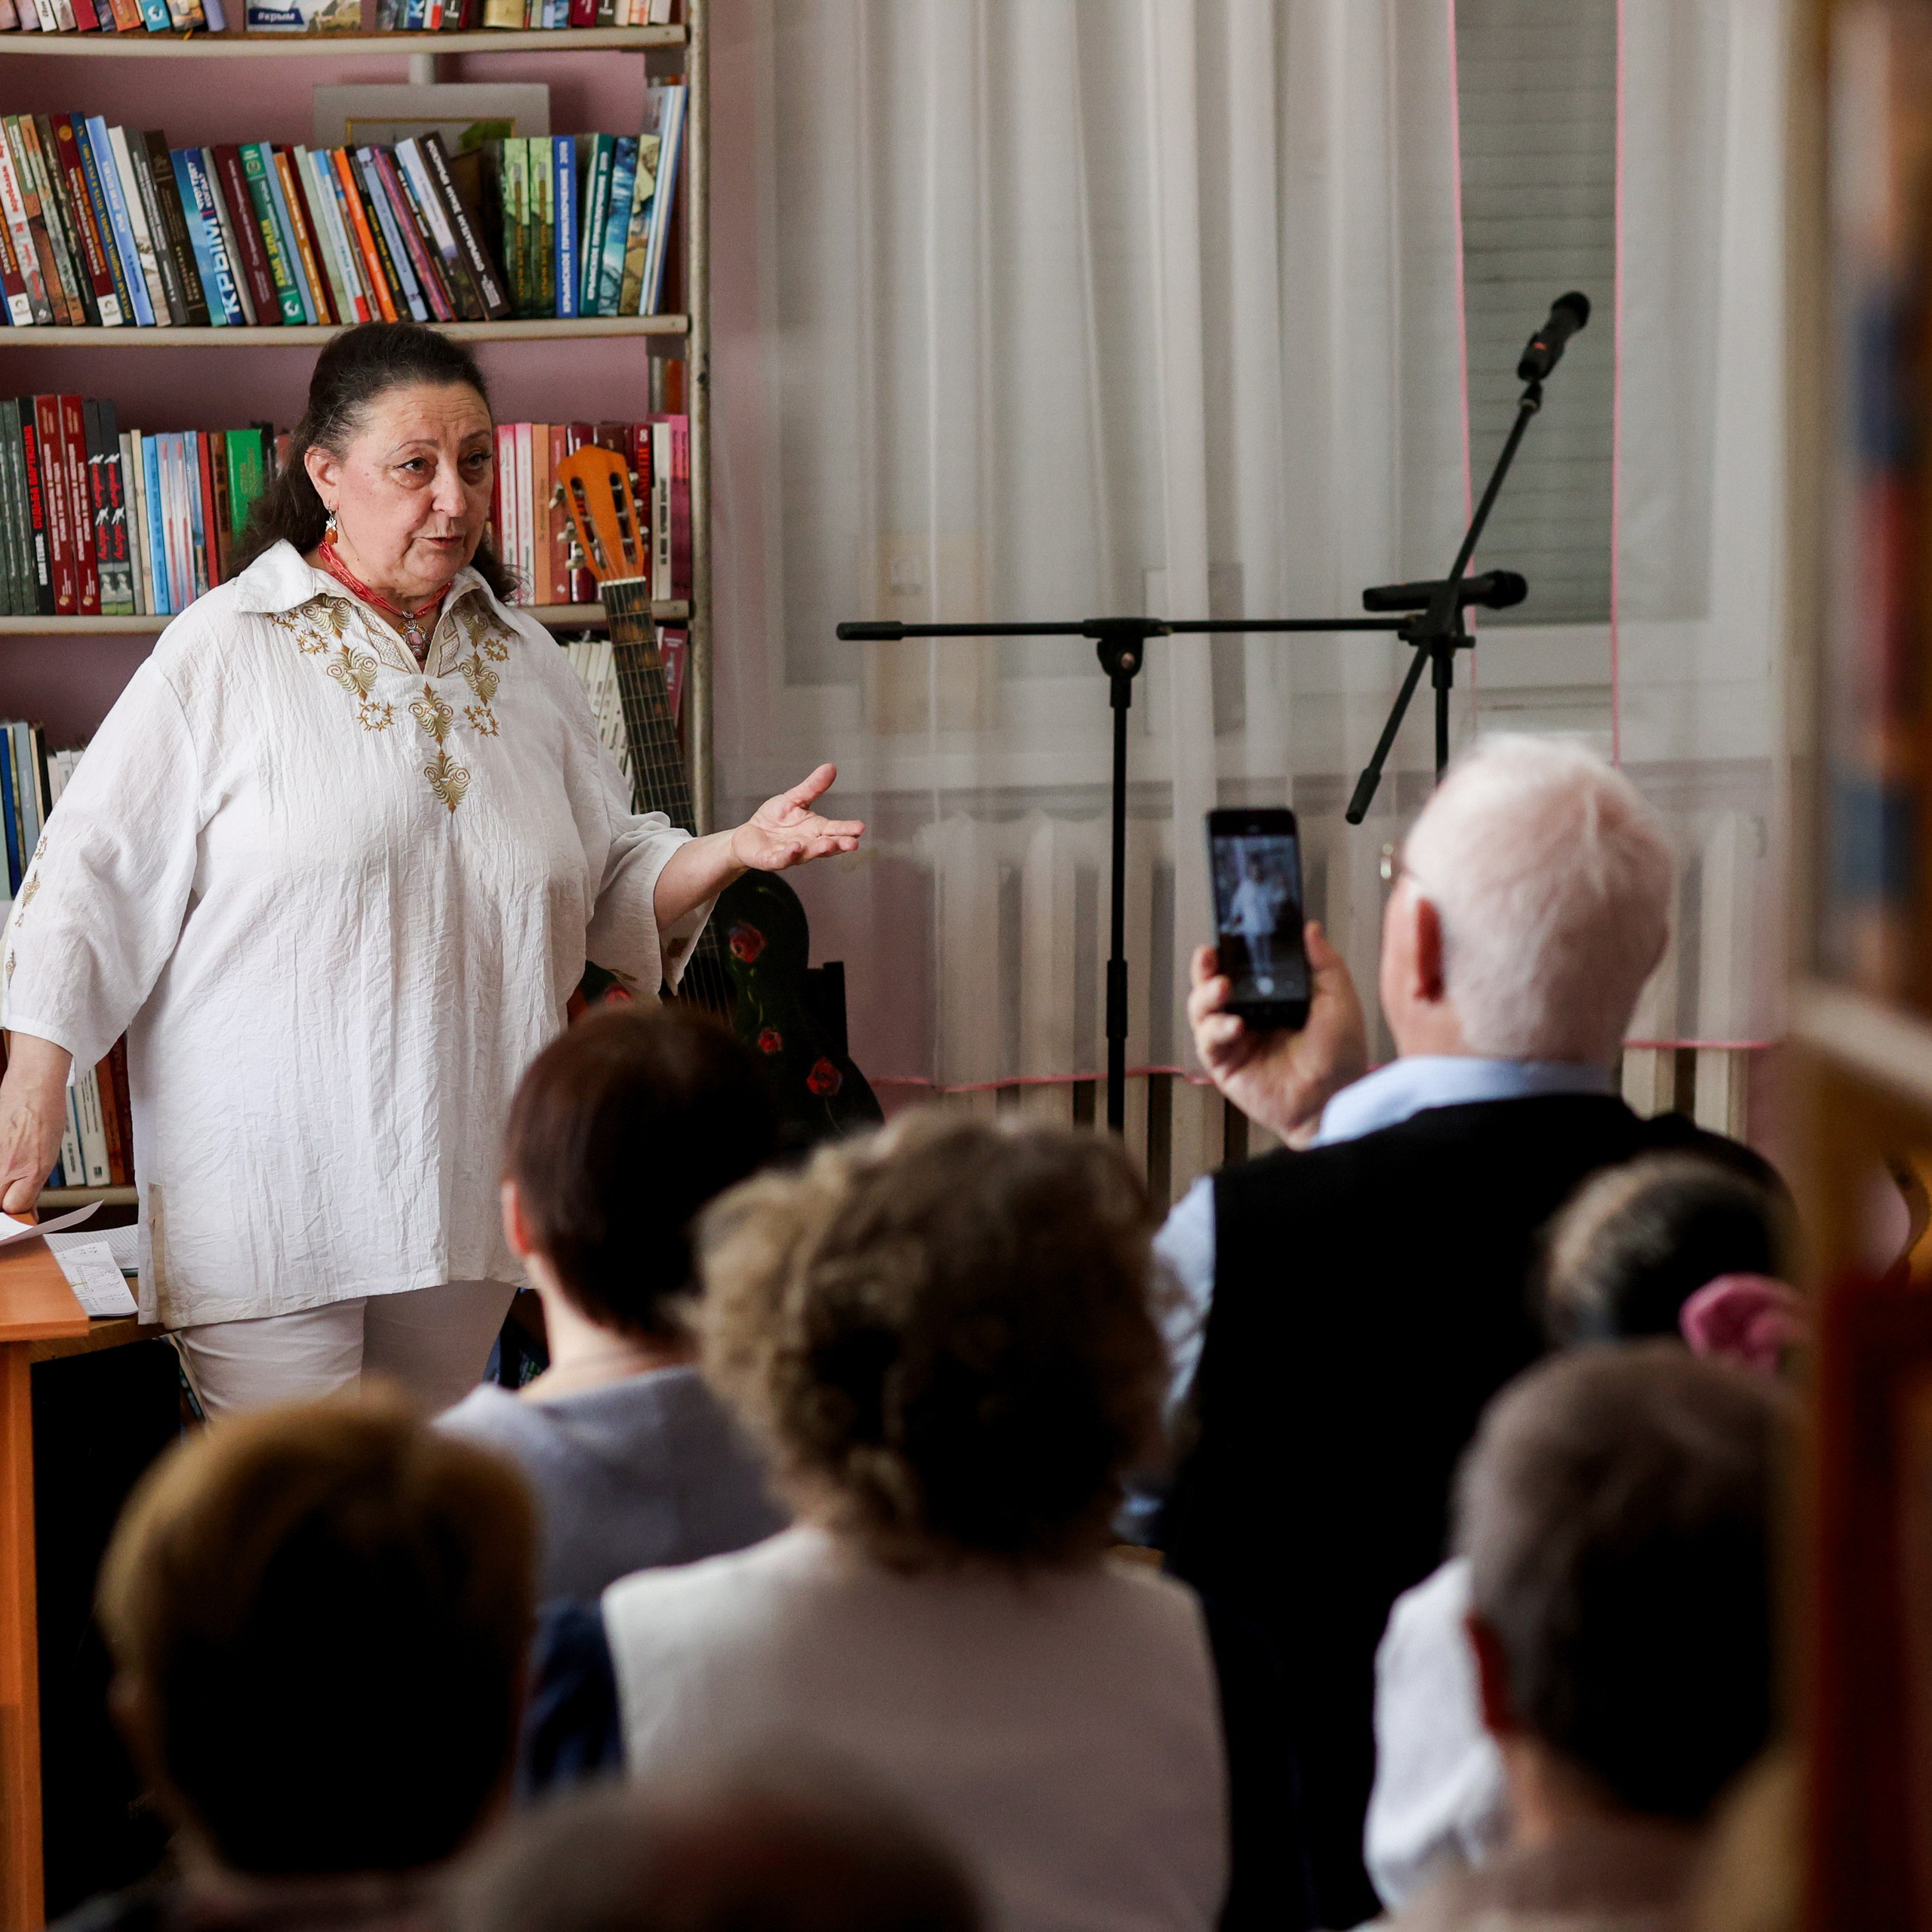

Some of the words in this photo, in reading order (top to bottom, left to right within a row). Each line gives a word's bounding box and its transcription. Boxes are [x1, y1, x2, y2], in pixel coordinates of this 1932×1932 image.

[201, 217, 242, 315] КРЫМ
[23, 425, 38, 485] ПАРТИЗАНА
[30, 487, 43, 529] СУДЬБА
